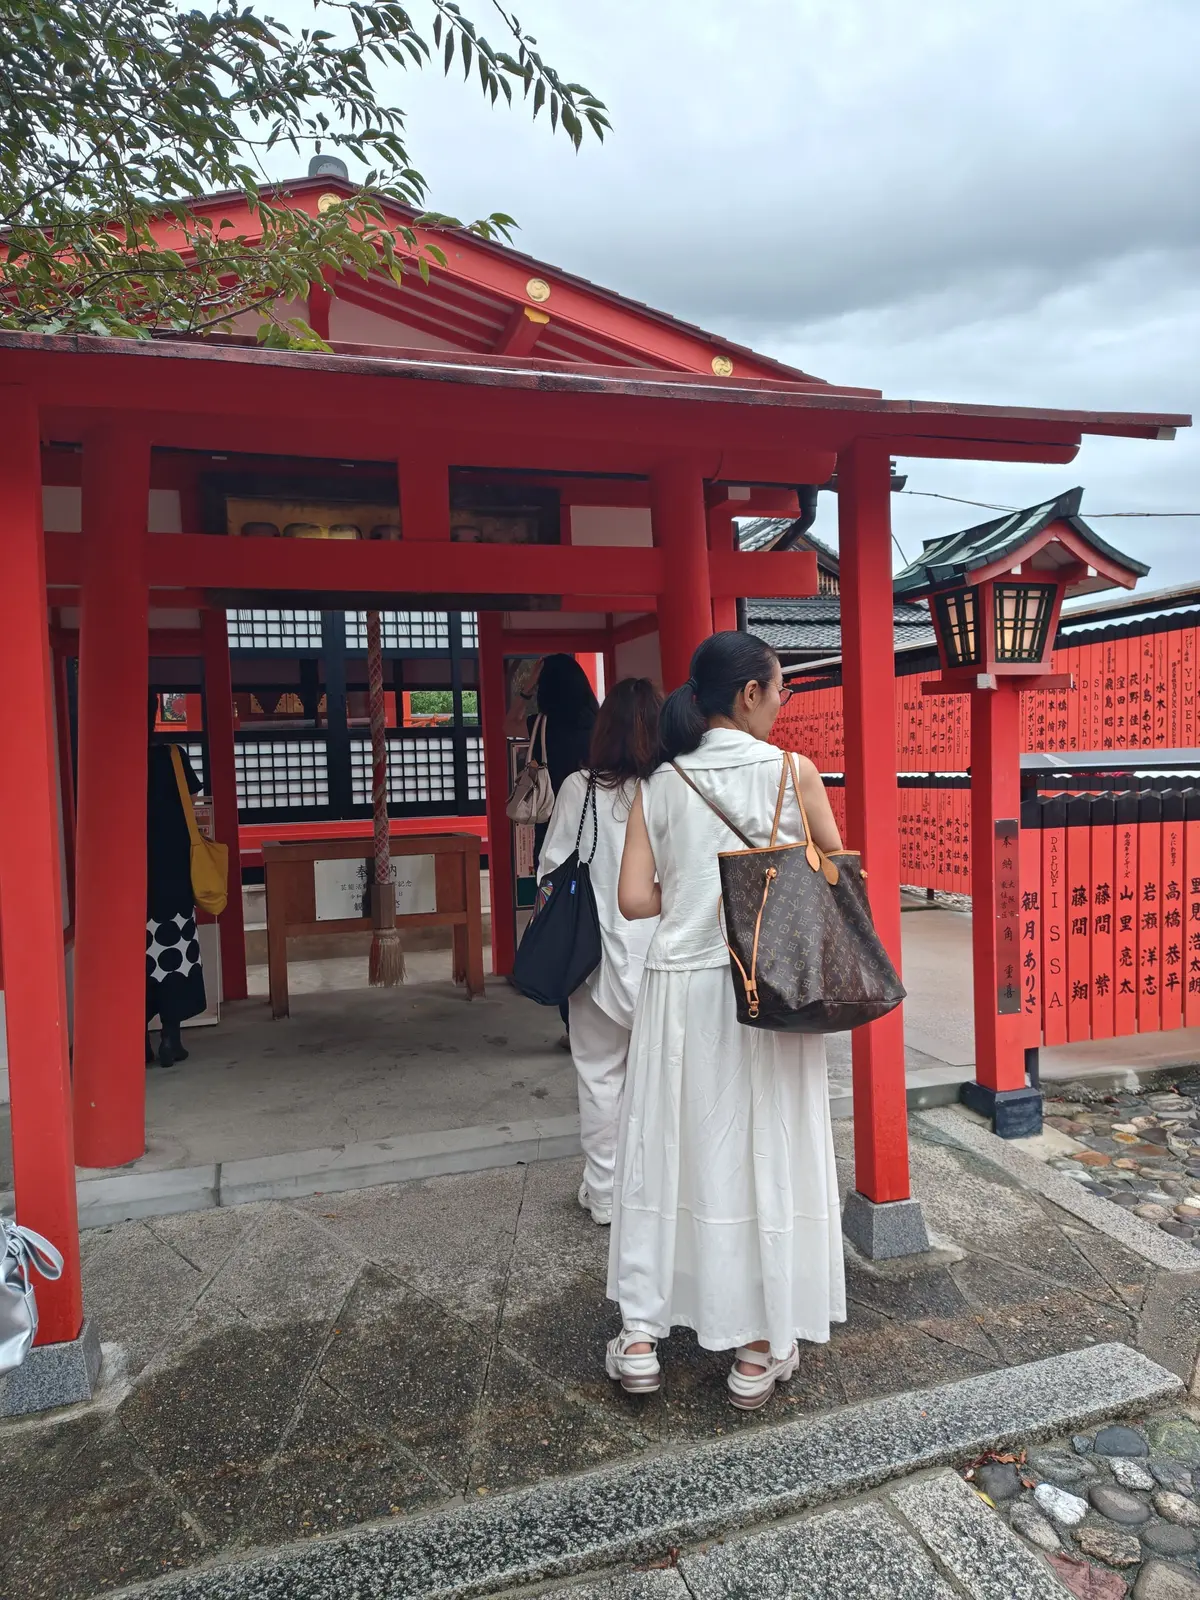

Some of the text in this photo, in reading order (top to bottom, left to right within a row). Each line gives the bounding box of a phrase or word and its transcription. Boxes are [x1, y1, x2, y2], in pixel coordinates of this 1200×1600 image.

[1021, 890, 1040, 1014] 観月ありさ
[1048, 892, 1063, 1009] ISSA
[1095, 882, 1111, 996] 藤間紫
[1118, 885, 1134, 995] 山里亮太
[1141, 881, 1158, 996] 岩瀬洋志
[1165, 880, 1181, 993] 高橋恭平
